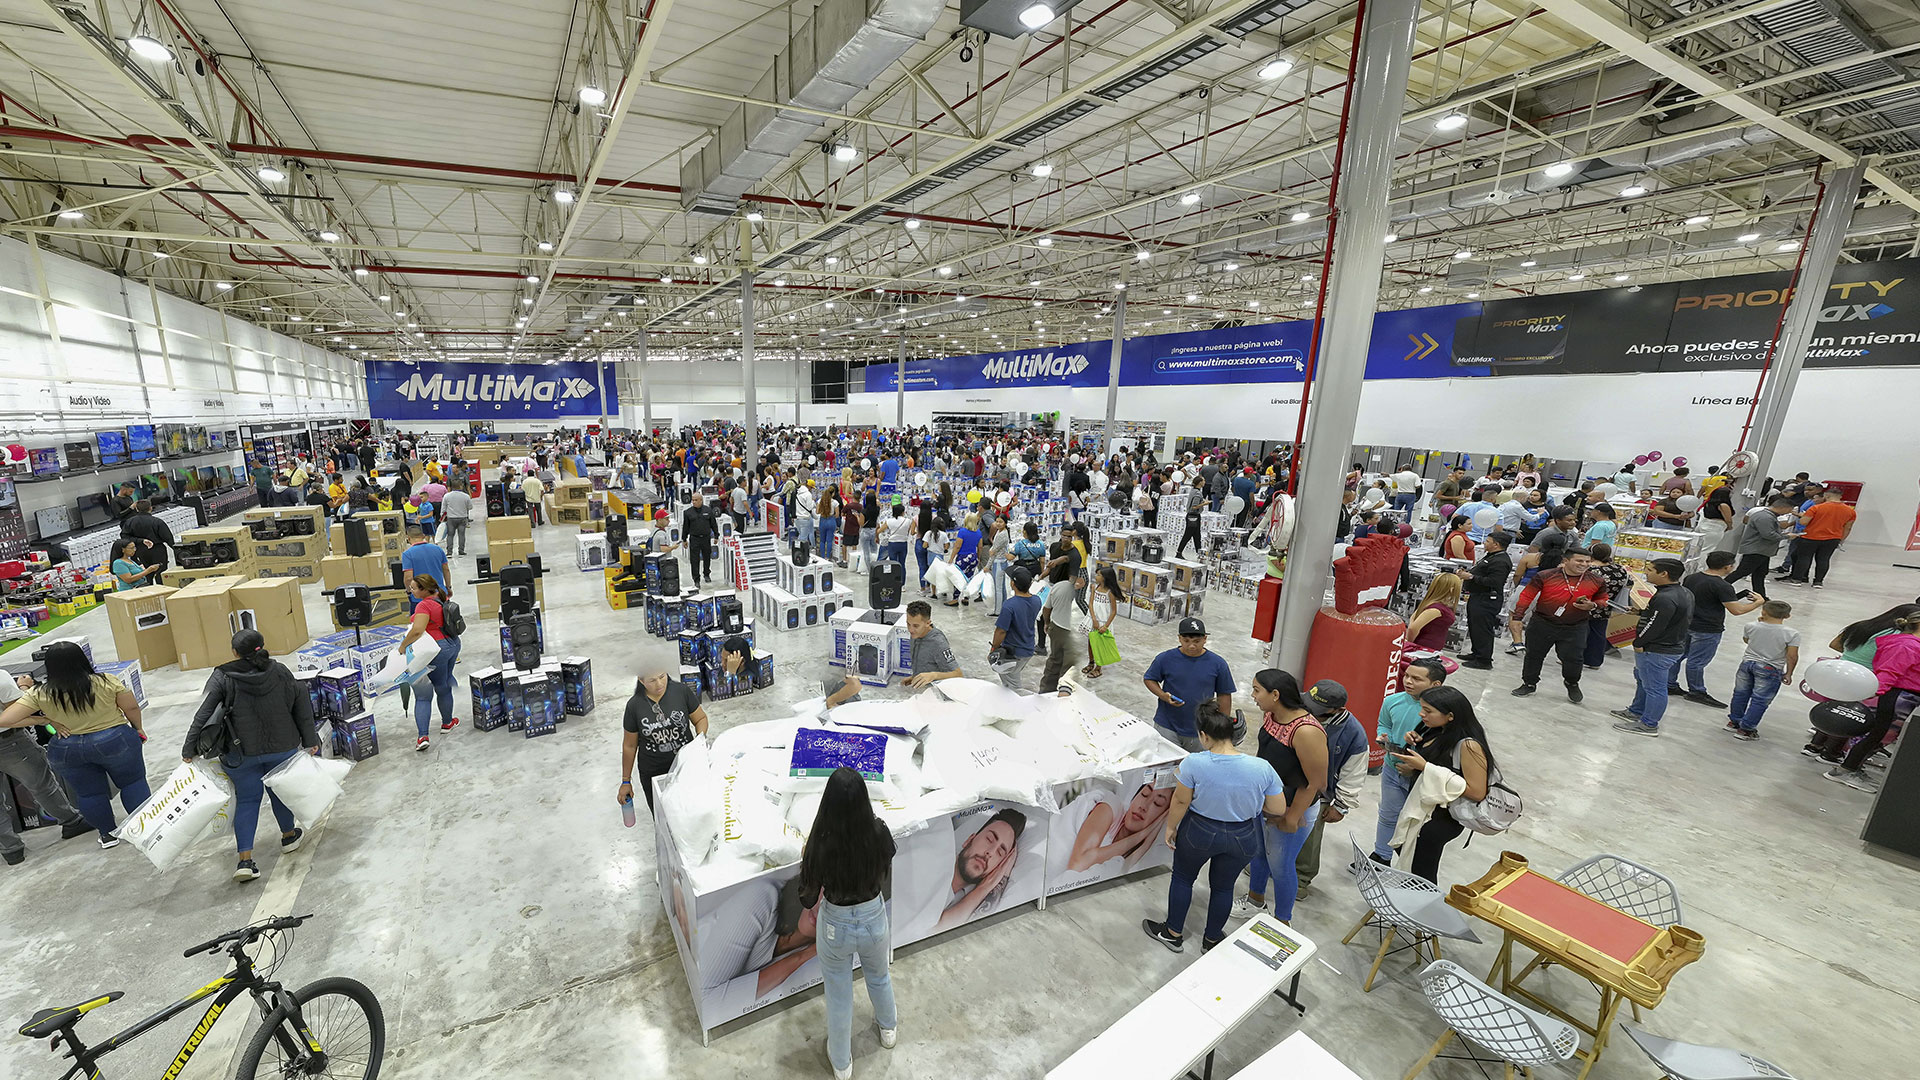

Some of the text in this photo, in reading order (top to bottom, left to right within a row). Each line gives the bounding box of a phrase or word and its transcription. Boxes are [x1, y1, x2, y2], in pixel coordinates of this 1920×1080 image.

[1674, 278, 1905, 312] PRIOTY
[1493, 314, 1567, 328] PRIORITY
[1527, 324, 1559, 334] Max
[1234, 341, 1261, 350] página
[1262, 339, 1283, 347] web!
[1625, 343, 1679, 355] Ahora
[1683, 339, 1760, 354] puedes
[1841, 331, 1920, 346] miem
[1168, 354, 1293, 369] www.multimaxstore.com
[1684, 352, 1752, 363] exclusivo
[985, 352, 1082, 380] MultiMax
[407, 373, 582, 401] MultiMax
[70, 395, 88, 405] Audio
[1691, 395, 1733, 405] Línea
[852, 632, 882, 642] OMEGA
[1384, 631, 1405, 700] DESA
[526, 682, 548, 694] OMEGA
[790, 981, 811, 993] Queen
